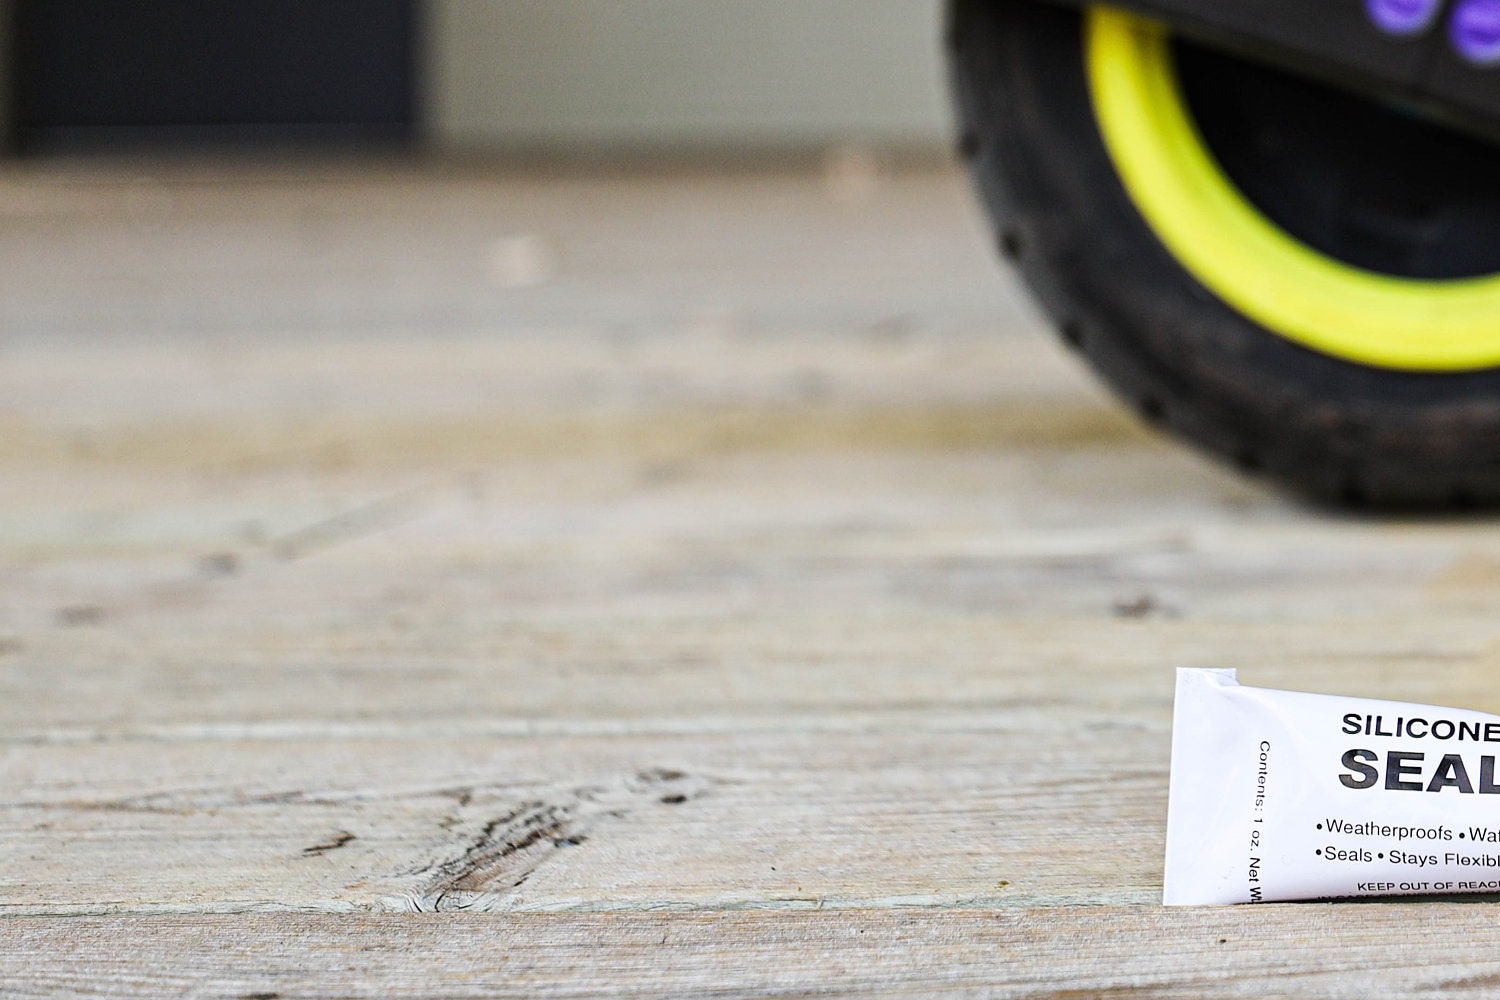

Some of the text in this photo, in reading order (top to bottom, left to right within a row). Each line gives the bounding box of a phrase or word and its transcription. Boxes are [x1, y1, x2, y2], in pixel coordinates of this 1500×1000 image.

[1255, 741, 1270, 811] Contents:
[1327, 819, 1453, 840] Weatherproofs
[1250, 830, 1260, 851] oz.
[1325, 847, 1372, 862] Seals
[1389, 850, 1438, 866] Stays
[1249, 857, 1260, 882] Net
[1358, 883, 1395, 891] KEEP
[1400, 882, 1429, 890] OUT
